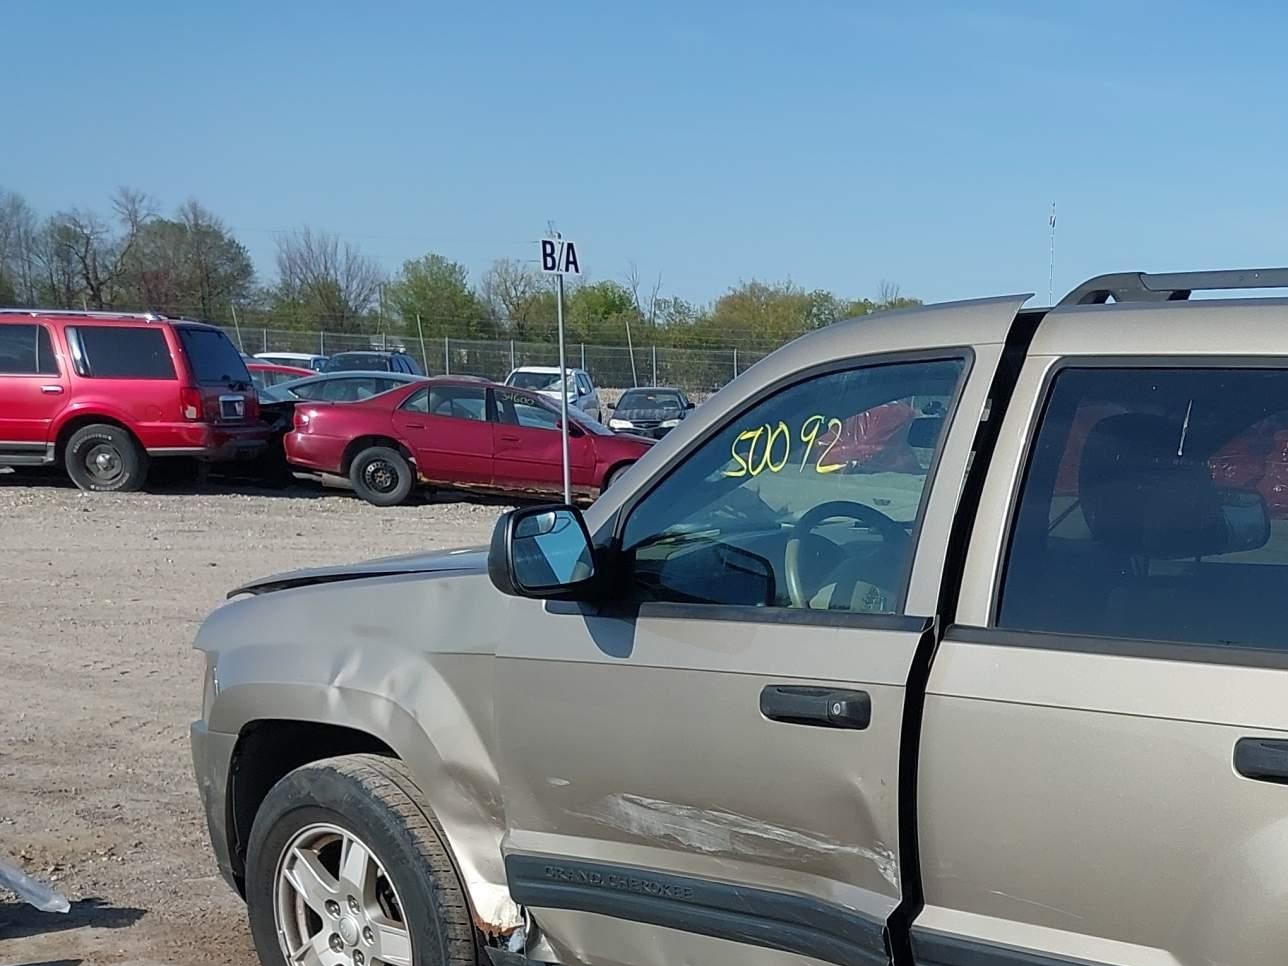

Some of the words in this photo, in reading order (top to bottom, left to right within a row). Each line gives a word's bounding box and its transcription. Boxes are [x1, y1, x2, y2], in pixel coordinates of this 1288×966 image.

[542, 239, 580, 274] B/A
[545, 865, 602, 884] GRAND
[608, 875, 696, 899] CHEROKEE
